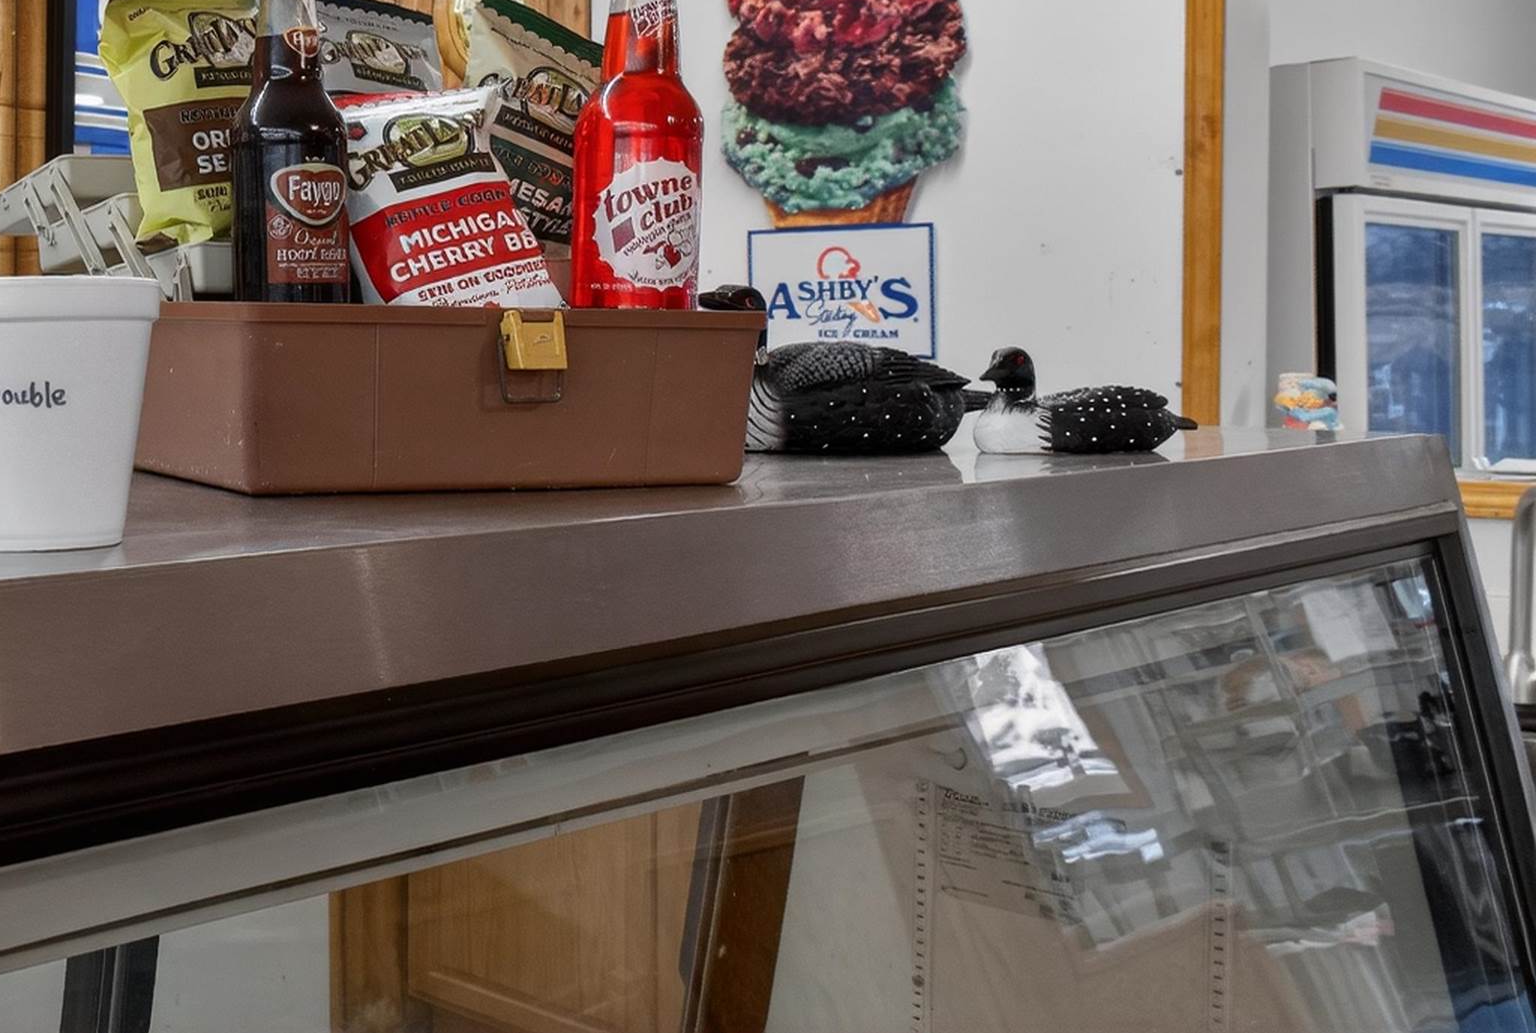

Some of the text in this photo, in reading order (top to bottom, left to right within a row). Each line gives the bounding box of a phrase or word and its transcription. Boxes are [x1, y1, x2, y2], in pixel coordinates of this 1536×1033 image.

[288, 175, 341, 207] Faygo
[603, 174, 693, 223] towne
[639, 193, 693, 231] club
[389, 236, 496, 283] CHERRY
[504, 231, 538, 252] BB
[766, 275, 920, 321] ASHBY'S
